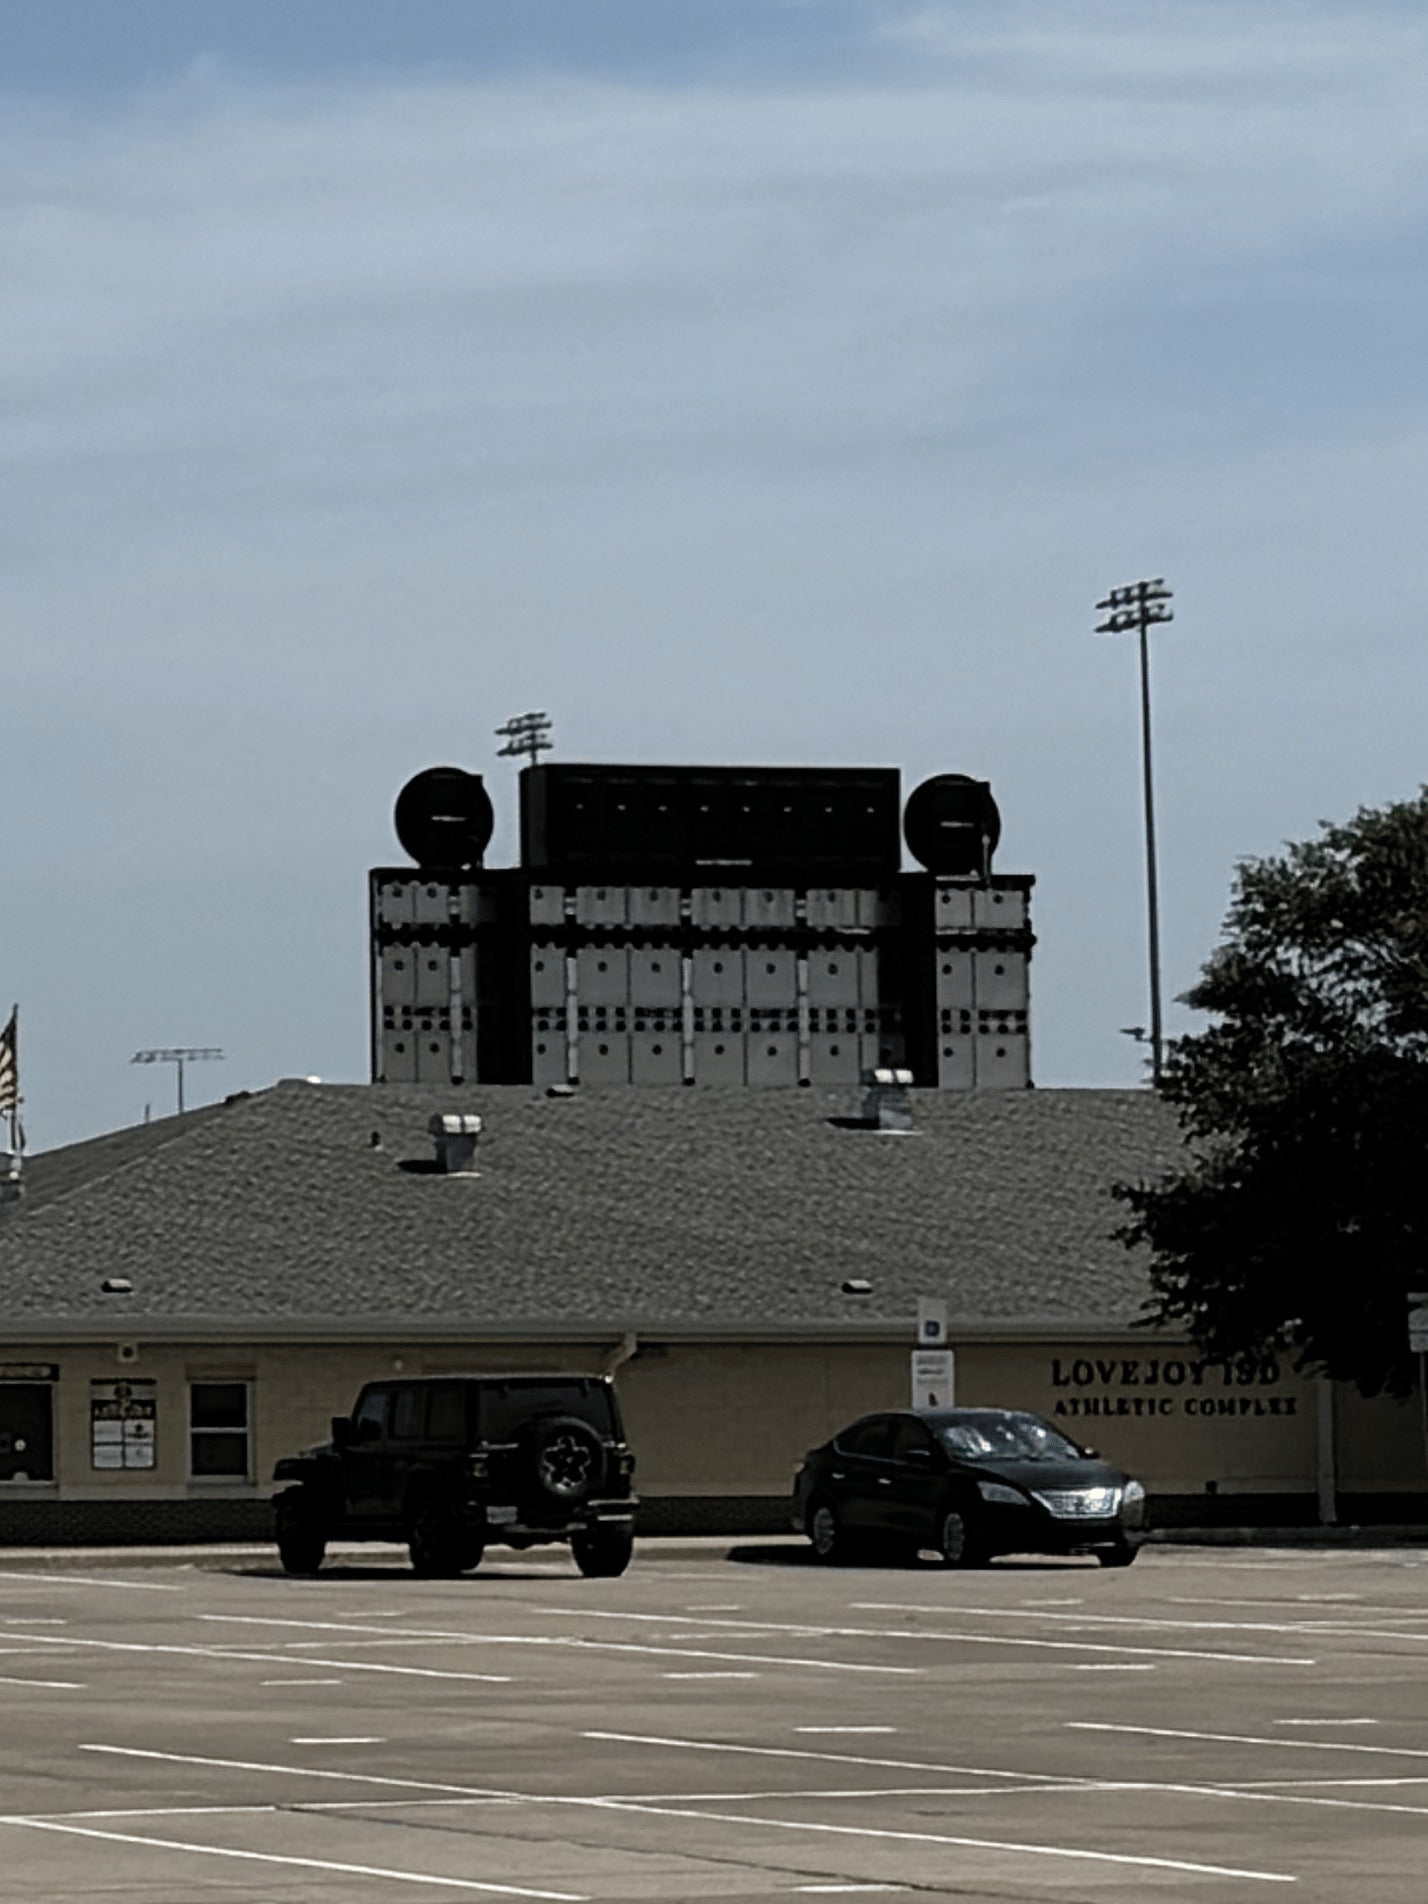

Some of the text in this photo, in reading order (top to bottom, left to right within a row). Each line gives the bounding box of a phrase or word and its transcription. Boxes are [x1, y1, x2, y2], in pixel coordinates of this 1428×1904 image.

[1051, 1358, 1281, 1387] LOVEJOY ISD
[1053, 1396, 1299, 1416] ATHLETIC COMPLEX
